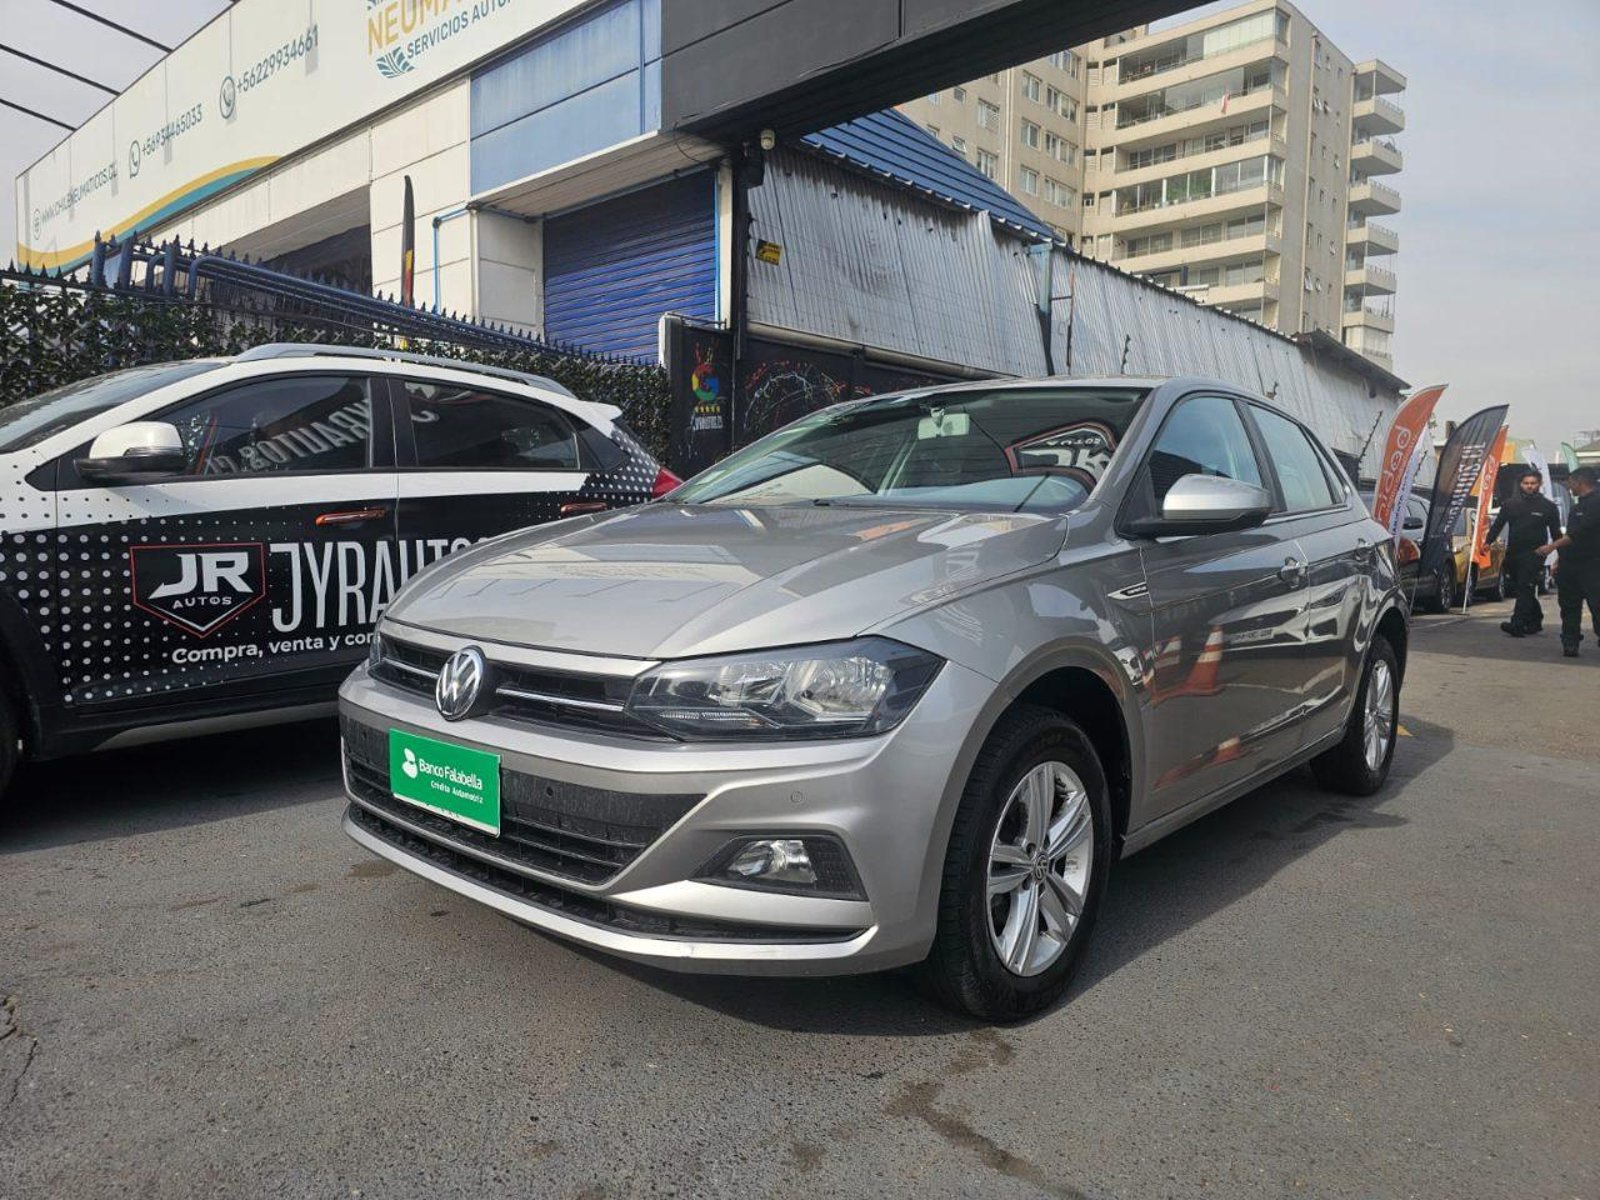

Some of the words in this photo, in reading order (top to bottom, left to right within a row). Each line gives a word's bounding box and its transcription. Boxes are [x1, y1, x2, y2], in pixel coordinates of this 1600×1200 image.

[406, 10, 469, 59] SERVICIOS
[237, 23, 319, 93] +56229934661
[148, 551, 254, 600] JR
[172, 596, 232, 609] AUTOS
[171, 643, 264, 664] Compra,
[268, 636, 324, 654] venta
[329, 635, 340, 651] y
[419, 758, 445, 778] Banco
[444, 765, 483, 790] Falabella
